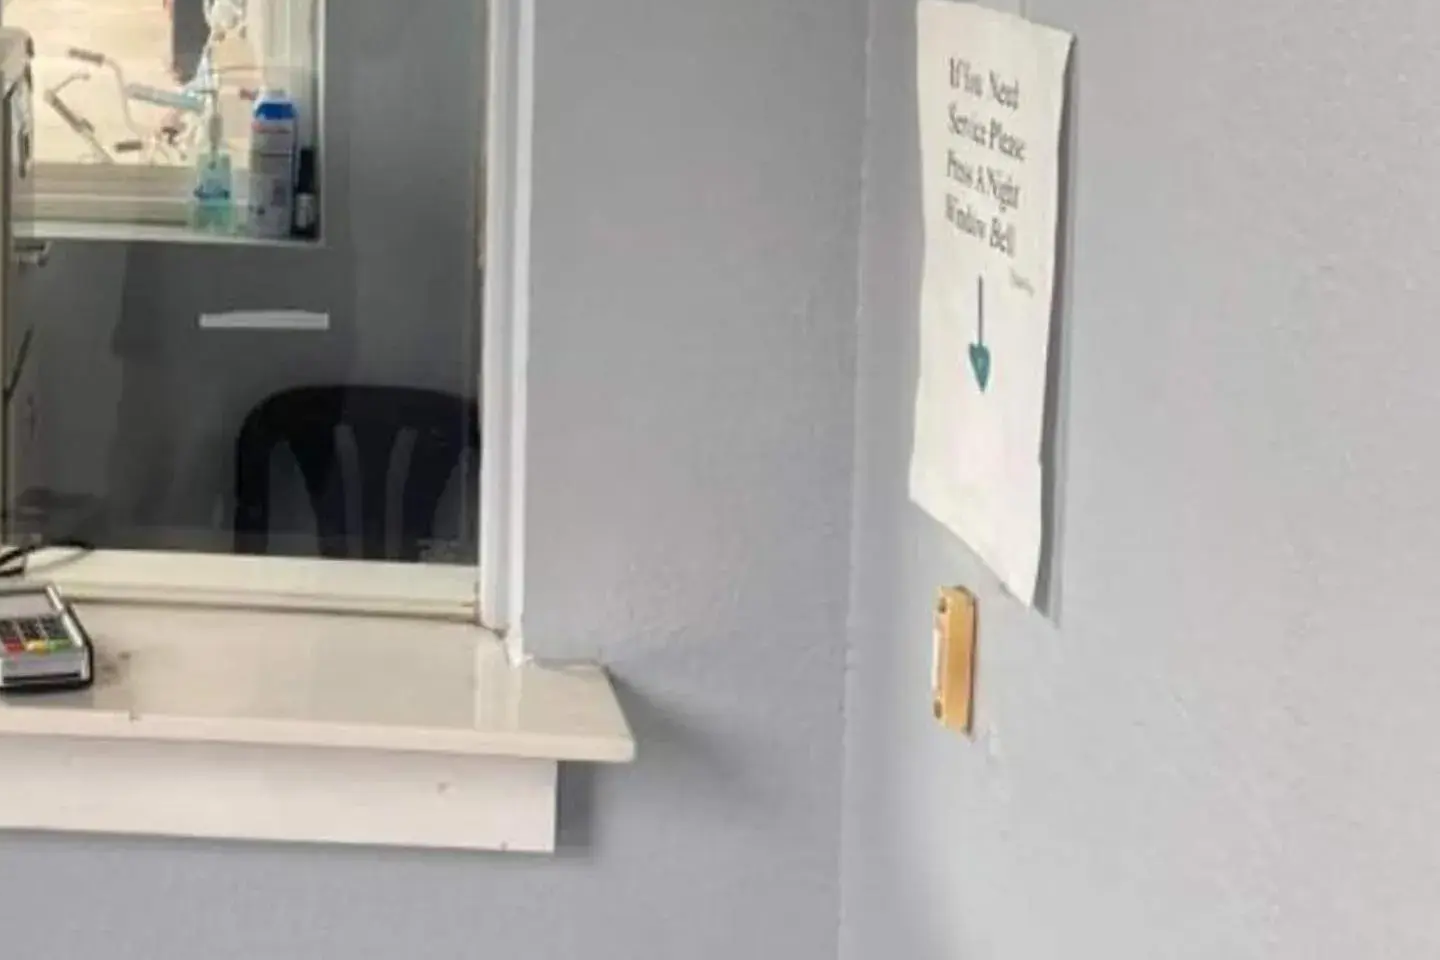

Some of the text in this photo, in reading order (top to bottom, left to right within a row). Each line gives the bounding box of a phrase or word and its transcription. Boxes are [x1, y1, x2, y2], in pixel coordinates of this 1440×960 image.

[989, 69, 1019, 110] Need
[947, 102, 1027, 161] Service Please
[946, 149, 973, 188] Press
[986, 166, 1019, 213] Night
[945, 194, 1015, 257] Window Bell
